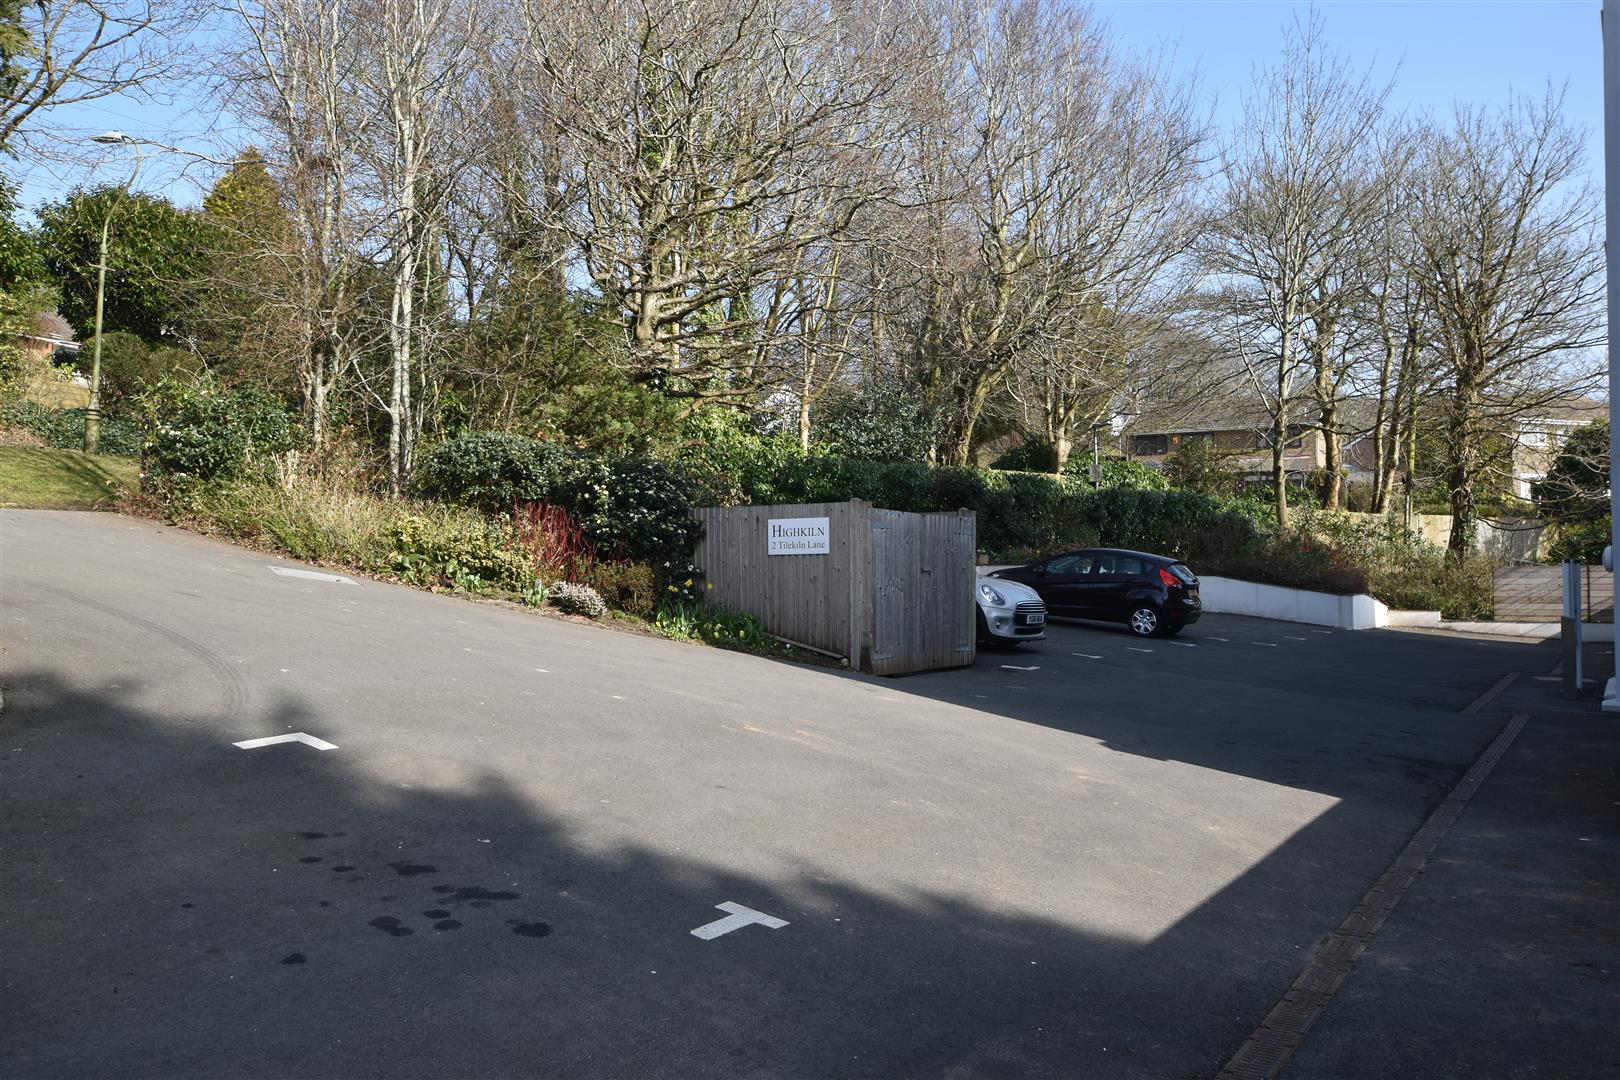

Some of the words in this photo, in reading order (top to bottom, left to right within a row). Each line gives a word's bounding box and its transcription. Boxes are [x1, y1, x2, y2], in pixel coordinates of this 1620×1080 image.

[772, 524, 825, 538] HIGHKILN
[771, 541, 777, 550] 2
[778, 541, 806, 550] Tilekiln
[807, 540, 826, 549] Lane
